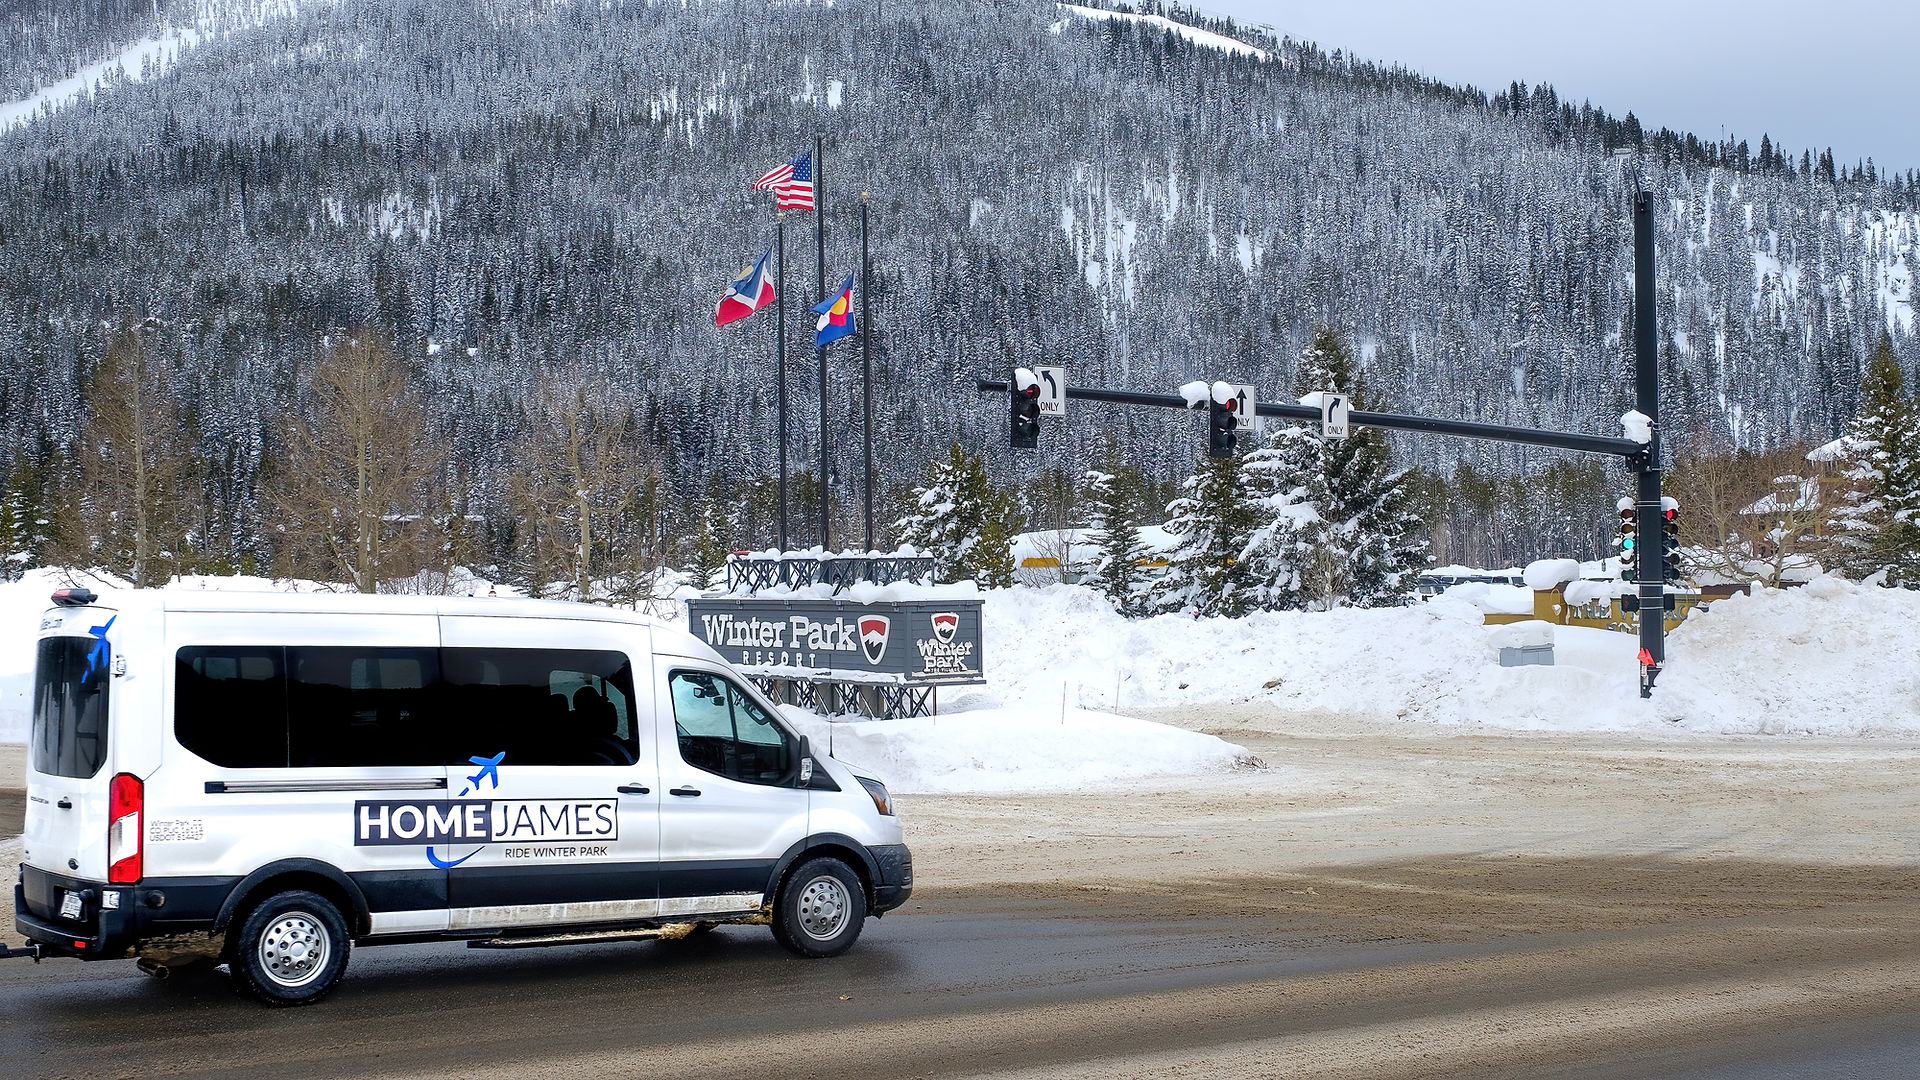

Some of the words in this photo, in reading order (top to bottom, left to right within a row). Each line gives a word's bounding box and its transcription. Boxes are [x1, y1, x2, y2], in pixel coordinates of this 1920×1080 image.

[1040, 401, 1059, 411] ONLY
[1237, 418, 1250, 427] NLY
[1327, 425, 1344, 435] ONLY
[701, 614, 787, 648] Winter
[789, 615, 858, 651] Park
[916, 638, 974, 657] Winter
[742, 651, 816, 668] RESORT
[360, 804, 487, 840] HOME
[495, 803, 613, 837] JAMES
[505, 848, 530, 858] RIDE
[533, 847, 577, 857] WINTER
[579, 846, 608, 856] PARK
